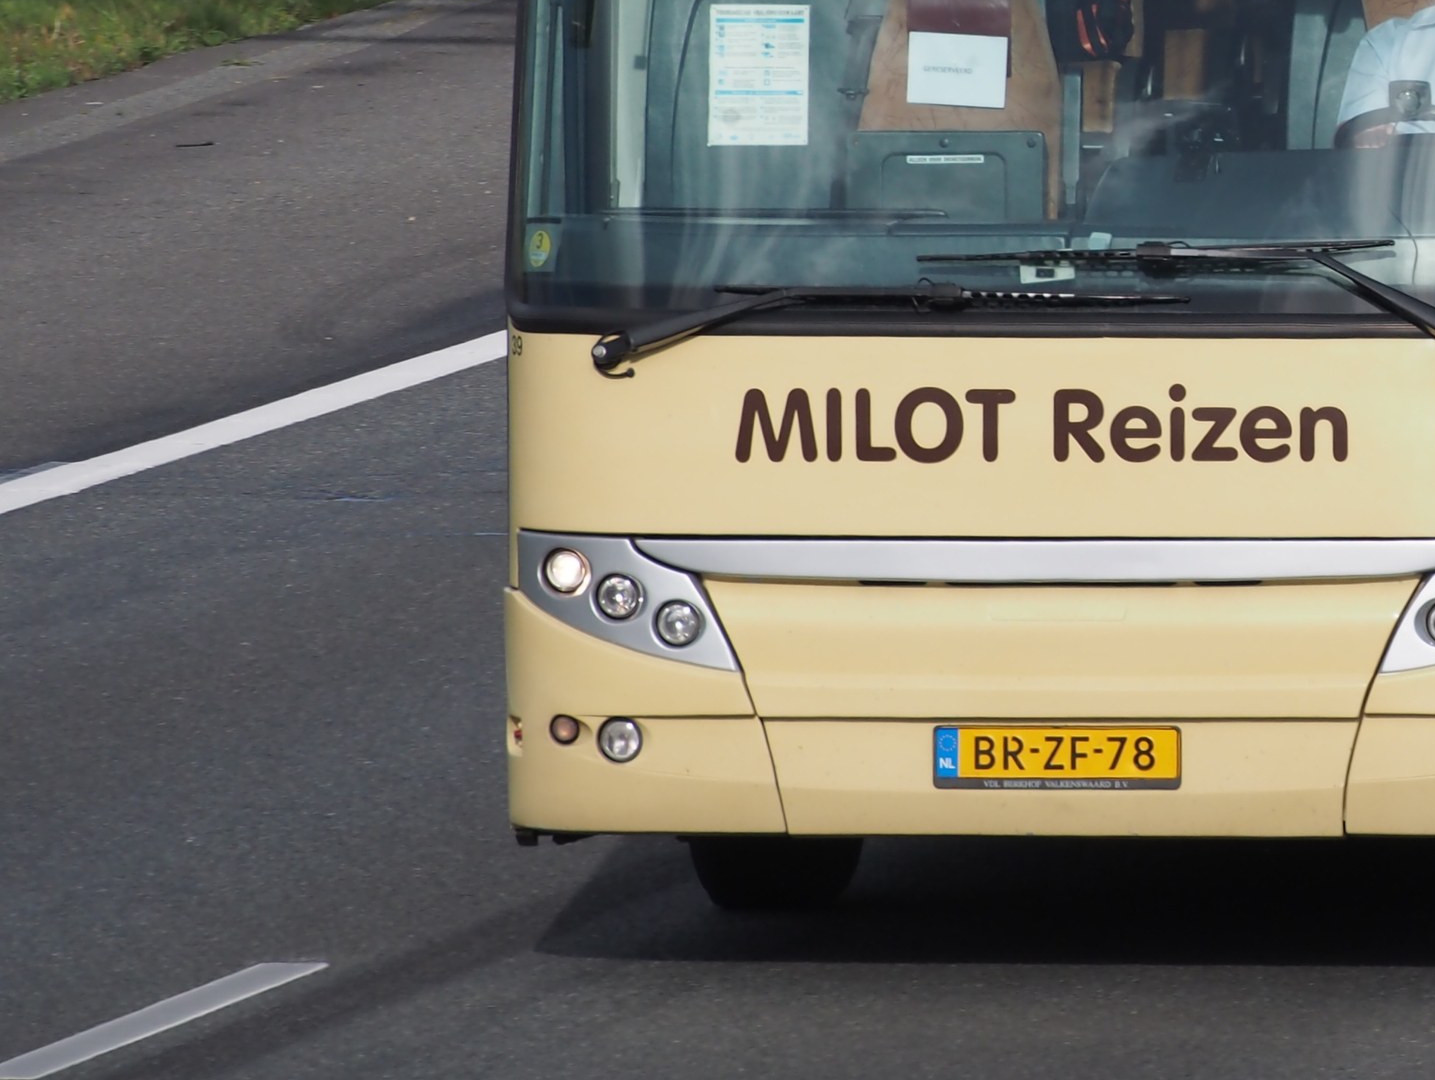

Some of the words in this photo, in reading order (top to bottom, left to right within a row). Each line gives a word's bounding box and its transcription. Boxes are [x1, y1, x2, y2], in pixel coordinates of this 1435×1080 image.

[536, 233, 543, 249] 3
[512, 334, 523, 356] 39
[735, 386, 1017, 464] MILOT
[1052, 383, 1349, 463] Reizen
[939, 757, 956, 769] NL
[974, 736, 1155, 771] BR-ZF-78
[983, 780, 1001, 789] VDL
